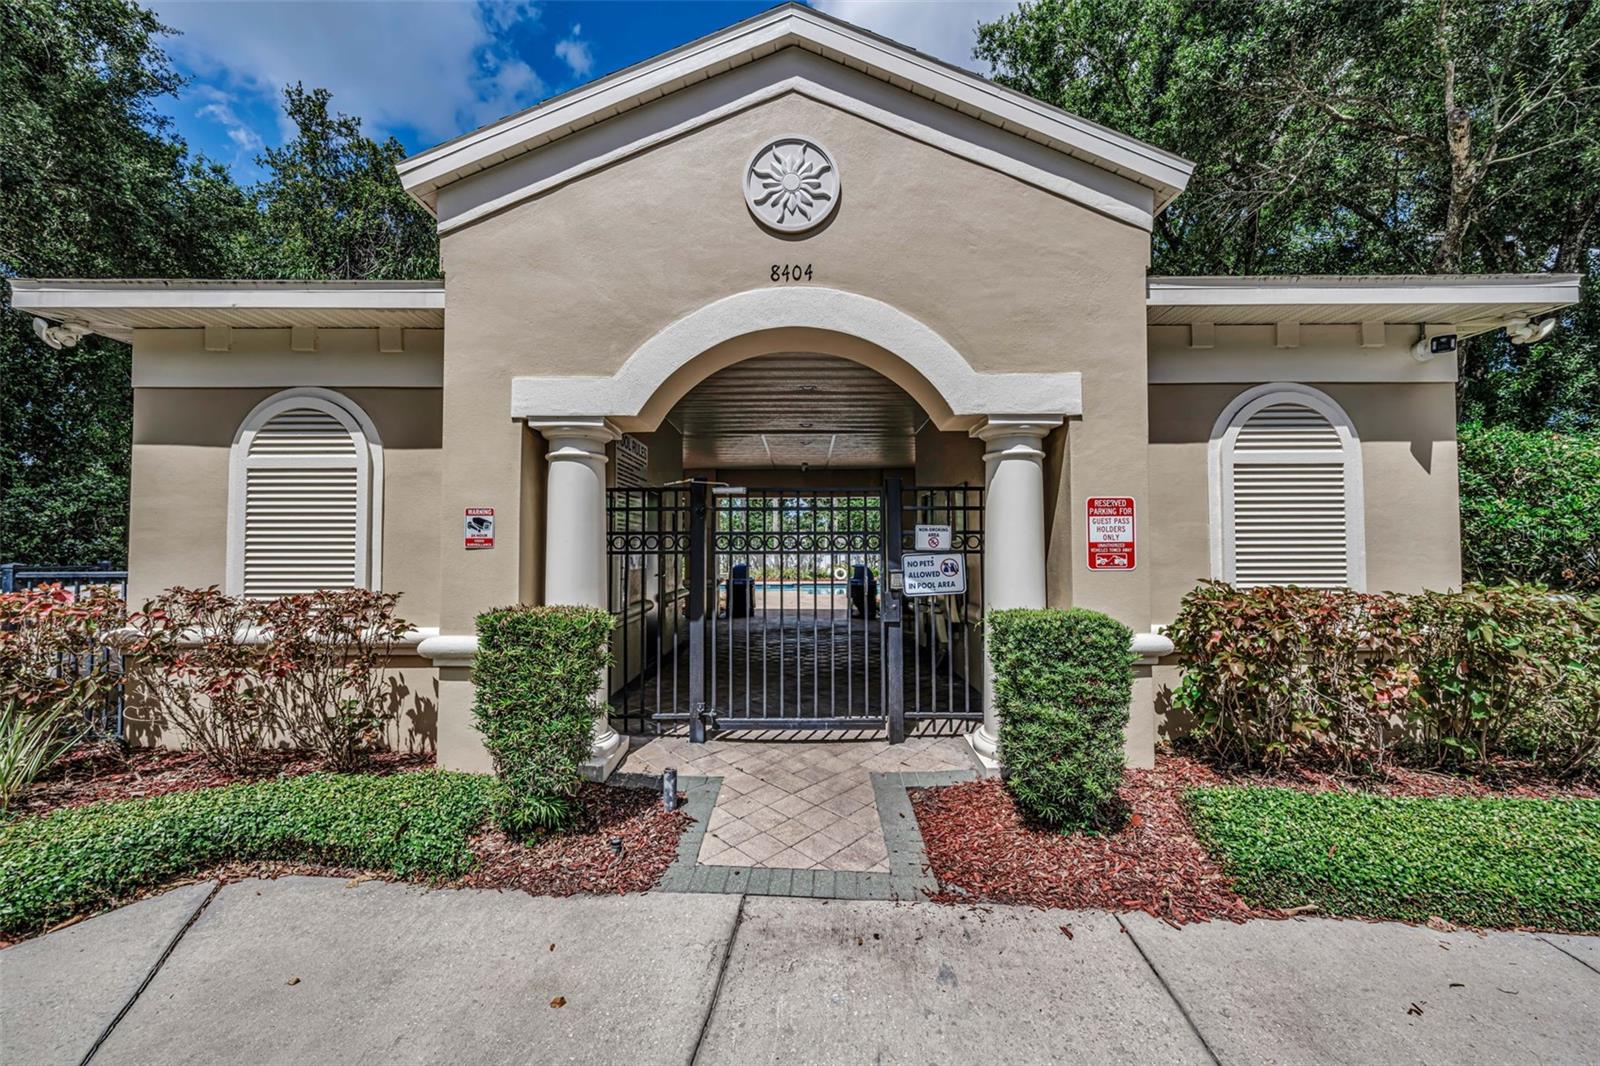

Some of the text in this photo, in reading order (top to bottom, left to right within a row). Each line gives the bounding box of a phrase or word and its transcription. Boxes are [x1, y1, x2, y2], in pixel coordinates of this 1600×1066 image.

[771, 264, 813, 282] 8404
[1094, 499, 1127, 507] RESERVED
[1089, 507, 1133, 515] PARKING FOR
[1092, 517, 1130, 525] GUEST PASS
[1096, 525, 1126, 533] HOLDERS
[1103, 533, 1120, 541] ONLY
[908, 570, 941, 578] ALLOWED
